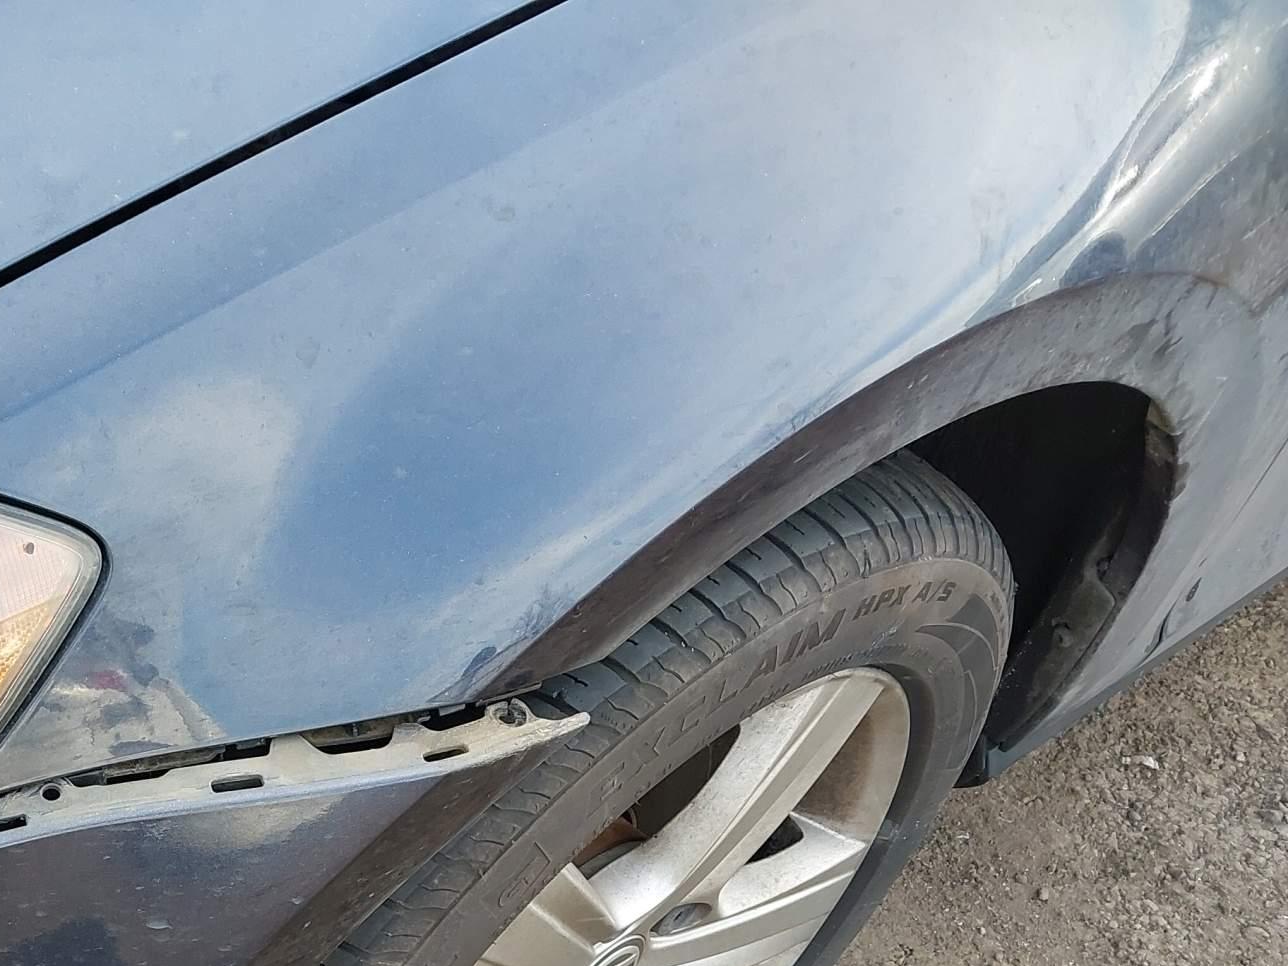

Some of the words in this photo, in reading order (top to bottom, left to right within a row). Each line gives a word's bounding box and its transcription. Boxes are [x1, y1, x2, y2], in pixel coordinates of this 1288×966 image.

[586, 607, 846, 815] EXCLAIM
[854, 584, 912, 621] HPX
[913, 580, 958, 604] A/S
